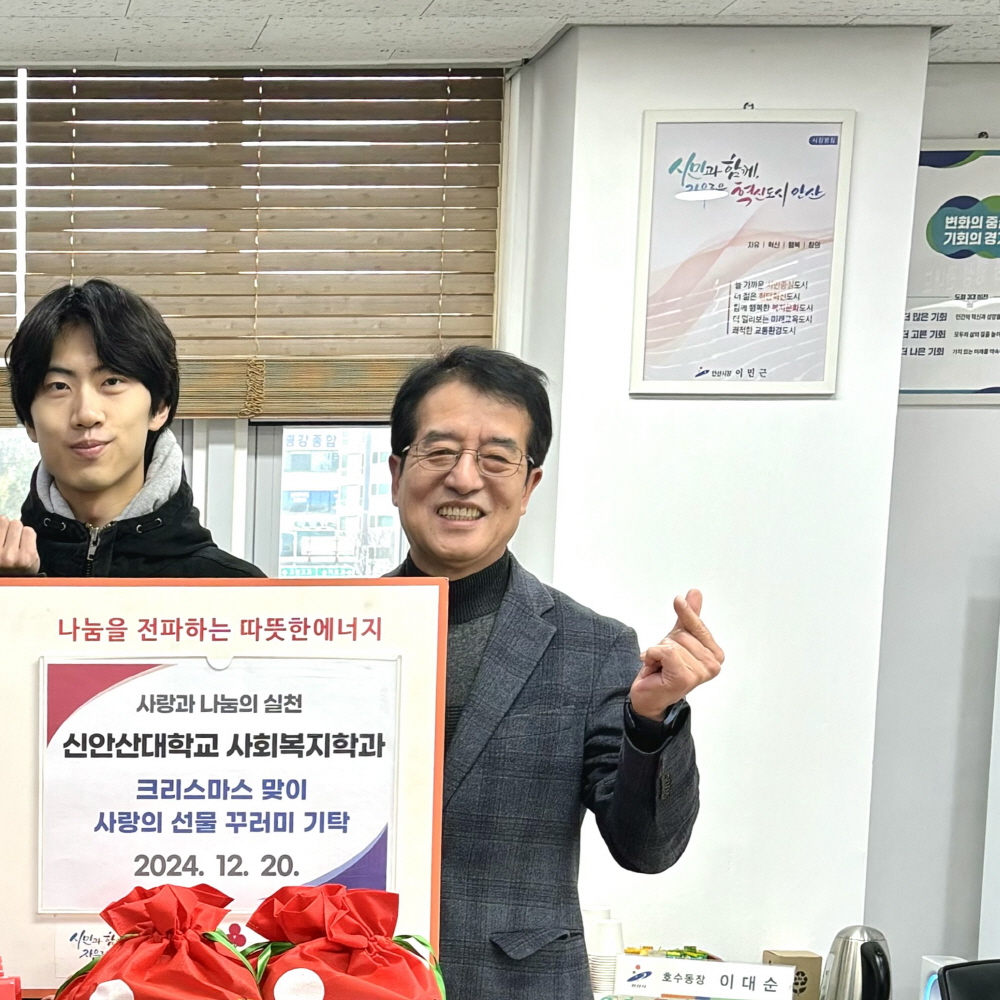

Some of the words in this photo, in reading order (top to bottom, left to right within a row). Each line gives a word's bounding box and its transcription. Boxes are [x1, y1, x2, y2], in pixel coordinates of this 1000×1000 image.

[731, 182, 788, 207] 혁신도시
[791, 184, 826, 200] 안산
[945, 215, 983, 229] 변화의
[986, 216, 1000, 229] 중
[943, 231, 982, 245] 기회의
[984, 232, 1000, 245] 경
[913, 312, 928, 321] 많은
[930, 312, 947, 321] 기회
[929, 330, 946, 339] 기회
[910, 347, 926, 356] 나은
[928, 347, 944, 356] 기회
[58, 617, 128, 642] 나눔을
[137, 617, 231, 642] 전파하는
[240, 617, 382, 642] 따뜻한에너지
[136, 694, 195, 713] 사랑과
[200, 694, 258, 713] 나눔의
[264, 694, 302, 713] 실천
[63, 732, 219, 758] 신안산대학교
[226, 732, 385, 758] 사회복지학과
[136, 779, 253, 800] 크리스마스
[262, 779, 307, 800] 맞이
[94, 812, 162, 833] 사랑의
[171, 812, 217, 833] 선물
[225, 812, 294, 833] 꾸러미
[304, 812, 350, 833] 기탁
[134, 854, 204, 877] 2024.
[216, 854, 249, 877] 12.
[260, 854, 299, 877] 20.
[662, 972, 706, 985] 호수동장
